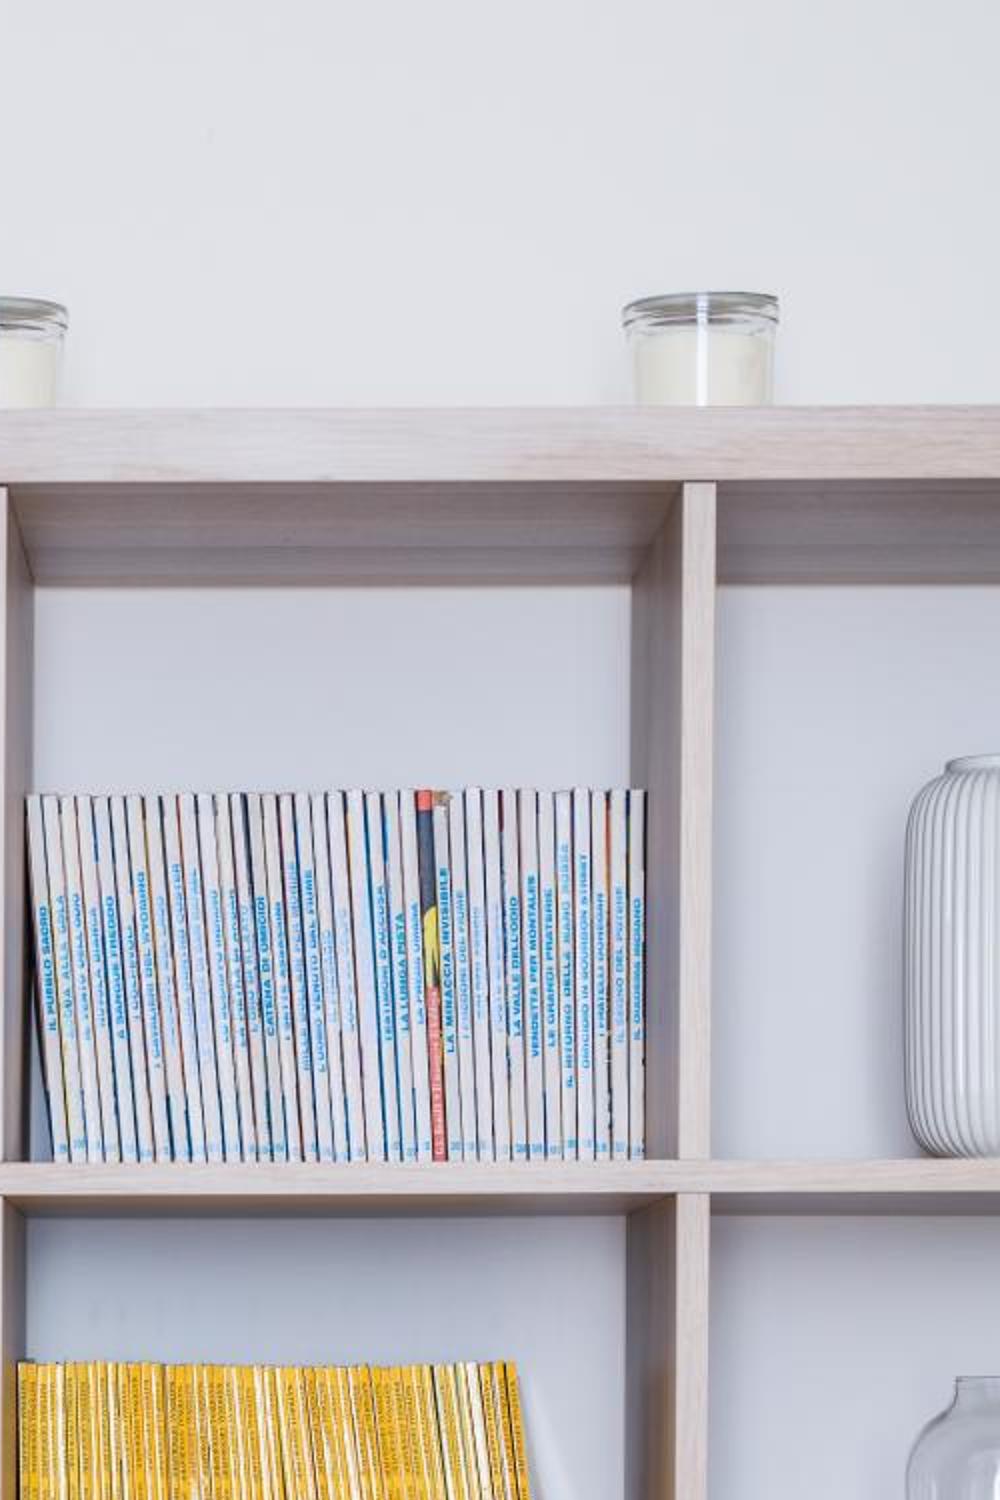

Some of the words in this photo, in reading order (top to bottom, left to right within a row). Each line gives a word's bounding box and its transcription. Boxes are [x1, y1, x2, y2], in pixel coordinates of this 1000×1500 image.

[39, 906, 51, 954] SACRO
[439, 868, 450, 945] INVISIBILE
[527, 875, 537, 950] MONTALES
[44, 959, 54, 1014] PUEBLO
[443, 952, 453, 1026] MINACCIA
[511, 973, 521, 1014] VALLE
[529, 955, 539, 982] PER
[446, 1034, 455, 1053] LA
[529, 987, 540, 1057] VENDETTA
